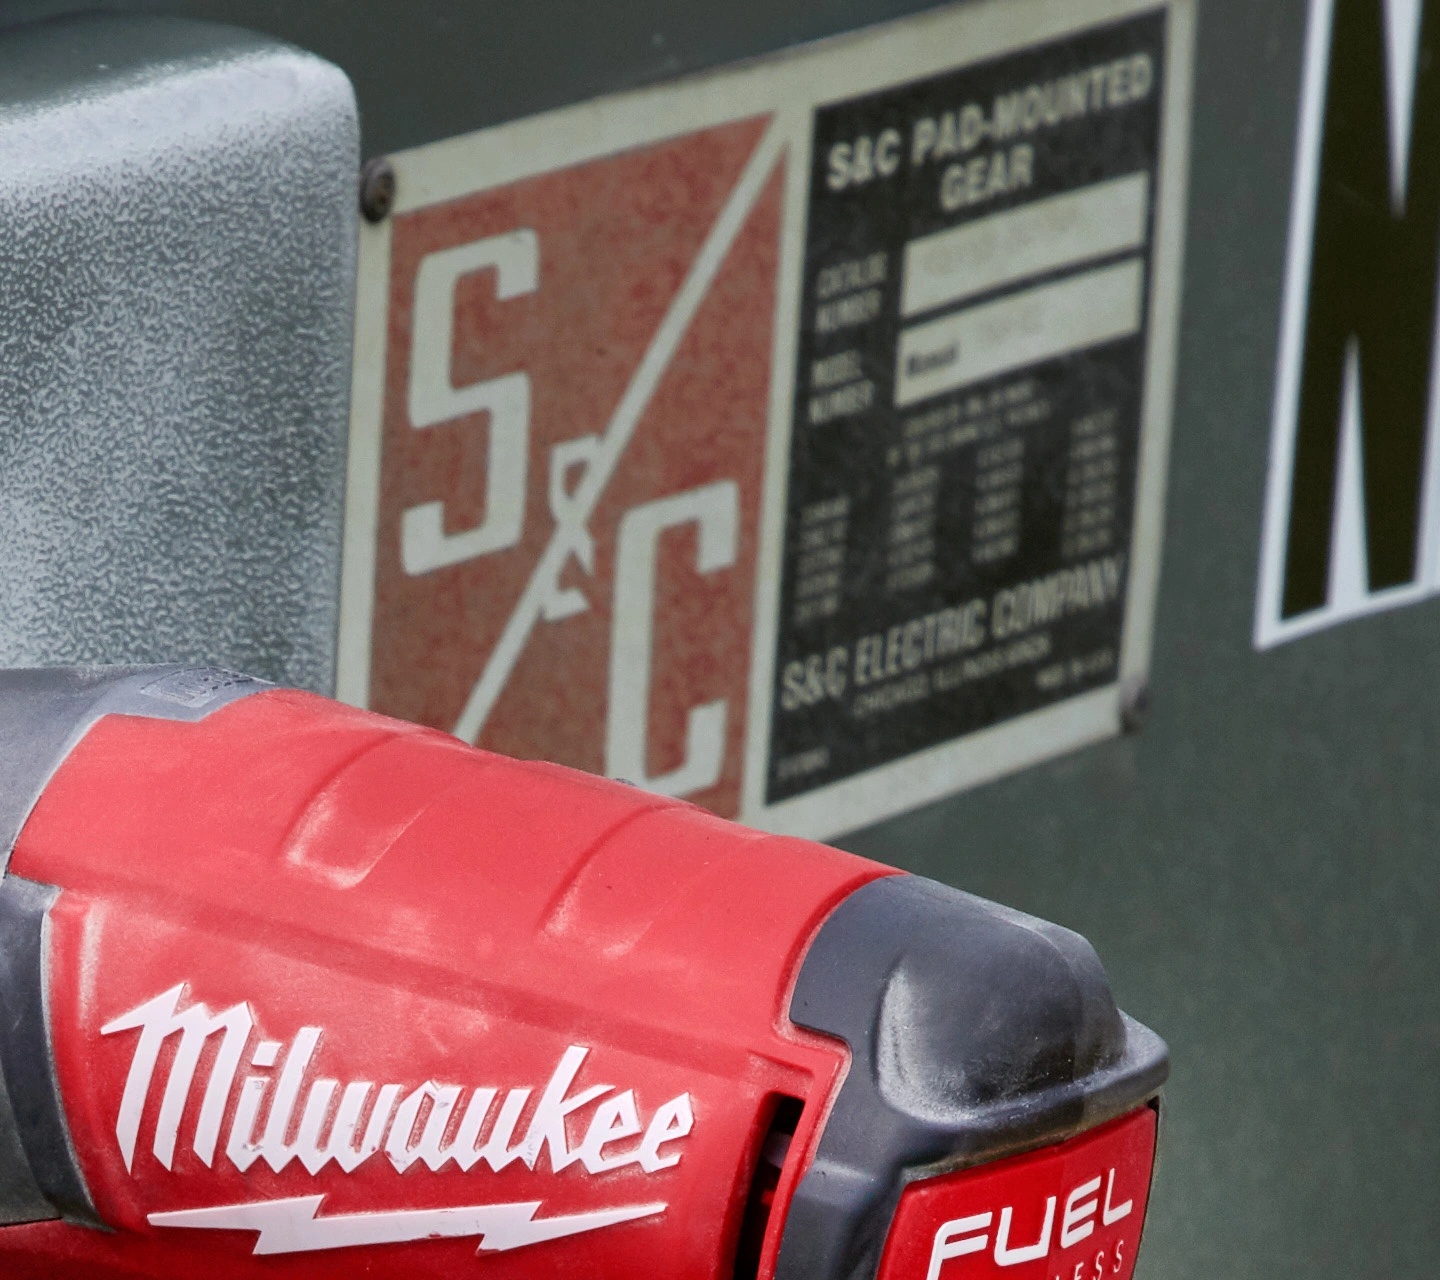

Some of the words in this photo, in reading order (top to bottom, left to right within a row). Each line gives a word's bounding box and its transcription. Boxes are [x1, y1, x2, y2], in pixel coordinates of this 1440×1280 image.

[827, 127, 903, 192] S&C
[914, 54, 1150, 165] PAD-MOUNTED
[940, 144, 1033, 211] GEAR
[782, 644, 847, 711] S&C
[856, 595, 985, 686] ELECTRIC
[994, 554, 1122, 639] COMPANY
[101, 983, 695, 1175] Milwaukee
